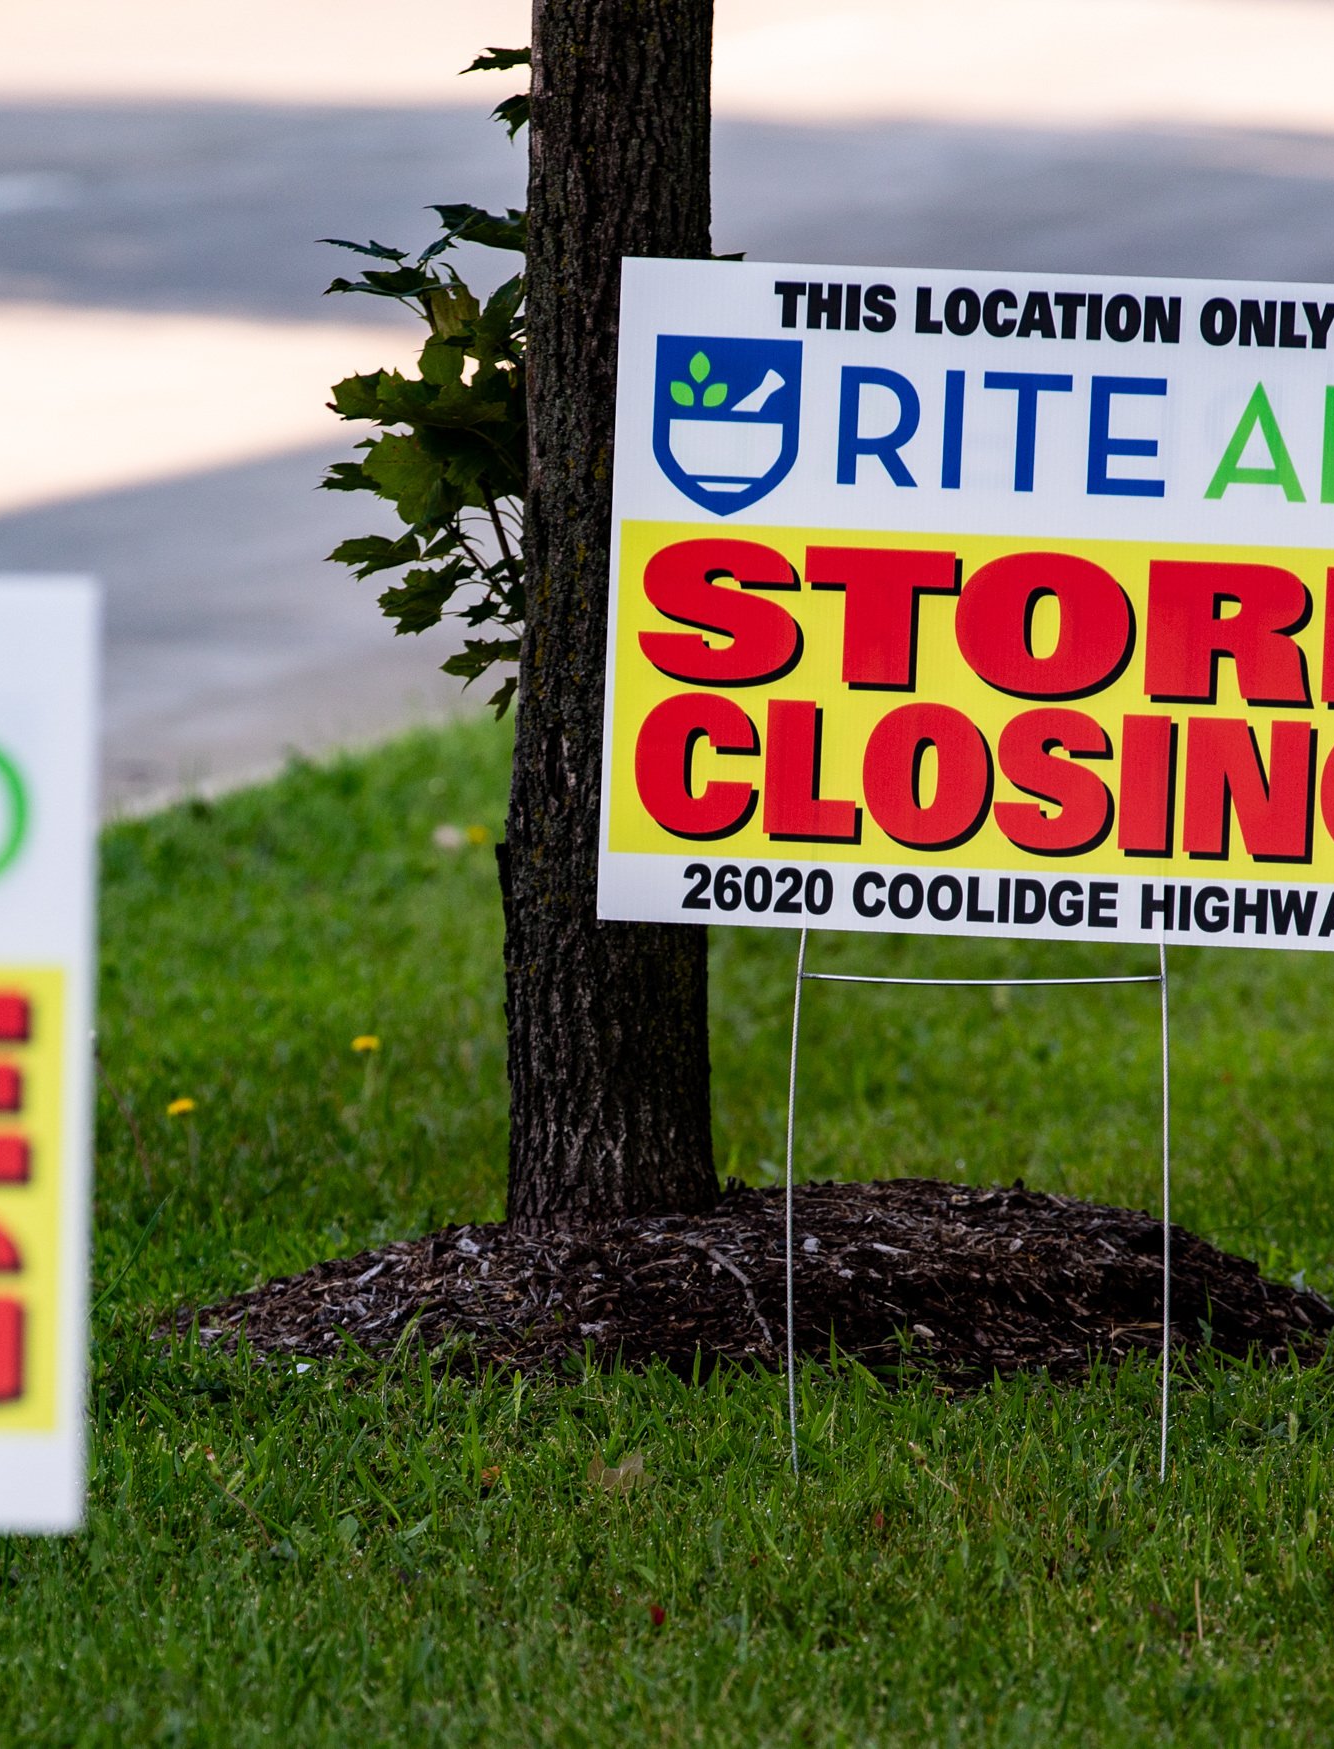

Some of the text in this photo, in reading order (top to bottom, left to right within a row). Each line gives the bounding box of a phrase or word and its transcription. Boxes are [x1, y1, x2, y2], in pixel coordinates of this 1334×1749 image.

[774, 281, 897, 334] THIS
[915, 287, 1182, 344] LOCATION
[836, 365, 1168, 498] RITE
[682, 864, 834, 917] 26020
[852, 872, 1119, 929] COOLIDGE
